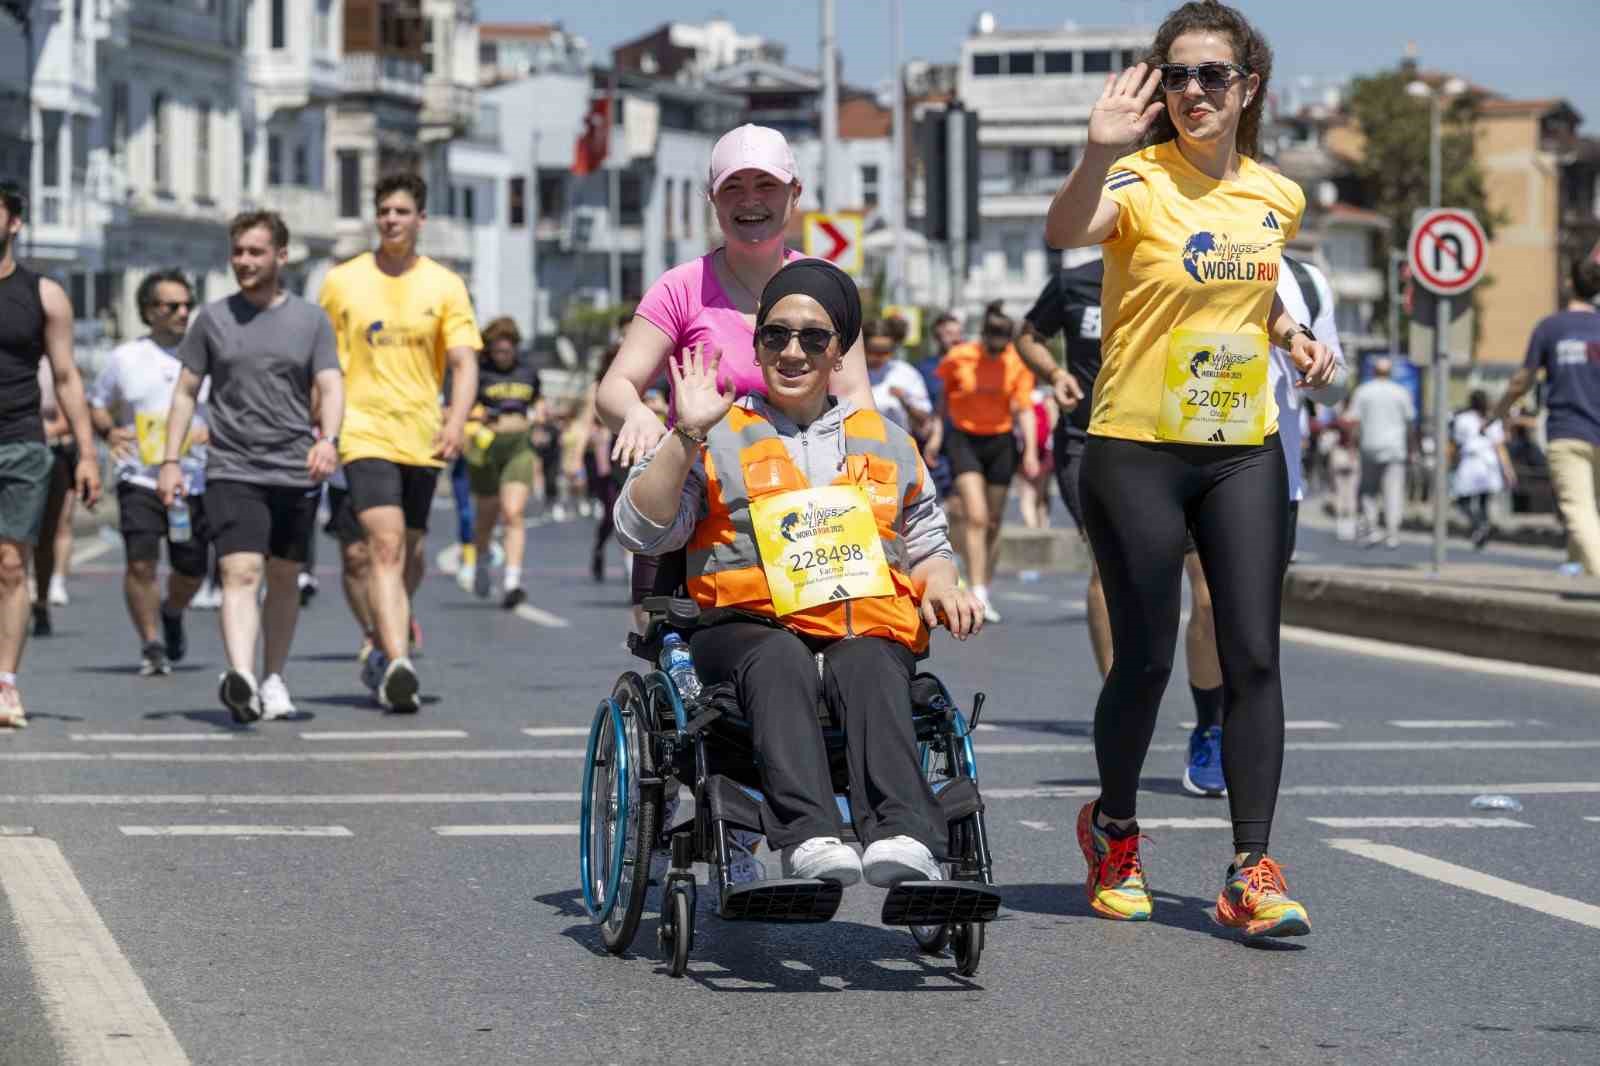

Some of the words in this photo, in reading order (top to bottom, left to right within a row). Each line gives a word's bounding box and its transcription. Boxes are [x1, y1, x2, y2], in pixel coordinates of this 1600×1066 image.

[1215, 243, 1252, 253] WINGS
[1221, 252, 1241, 261] LIFE
[1202, 261, 1256, 280] WORLD
[1186, 388, 1248, 409] 220751
[801, 508, 837, 521] WINGS
[808, 518, 829, 528] LIFE
[789, 543, 864, 573] 228498
